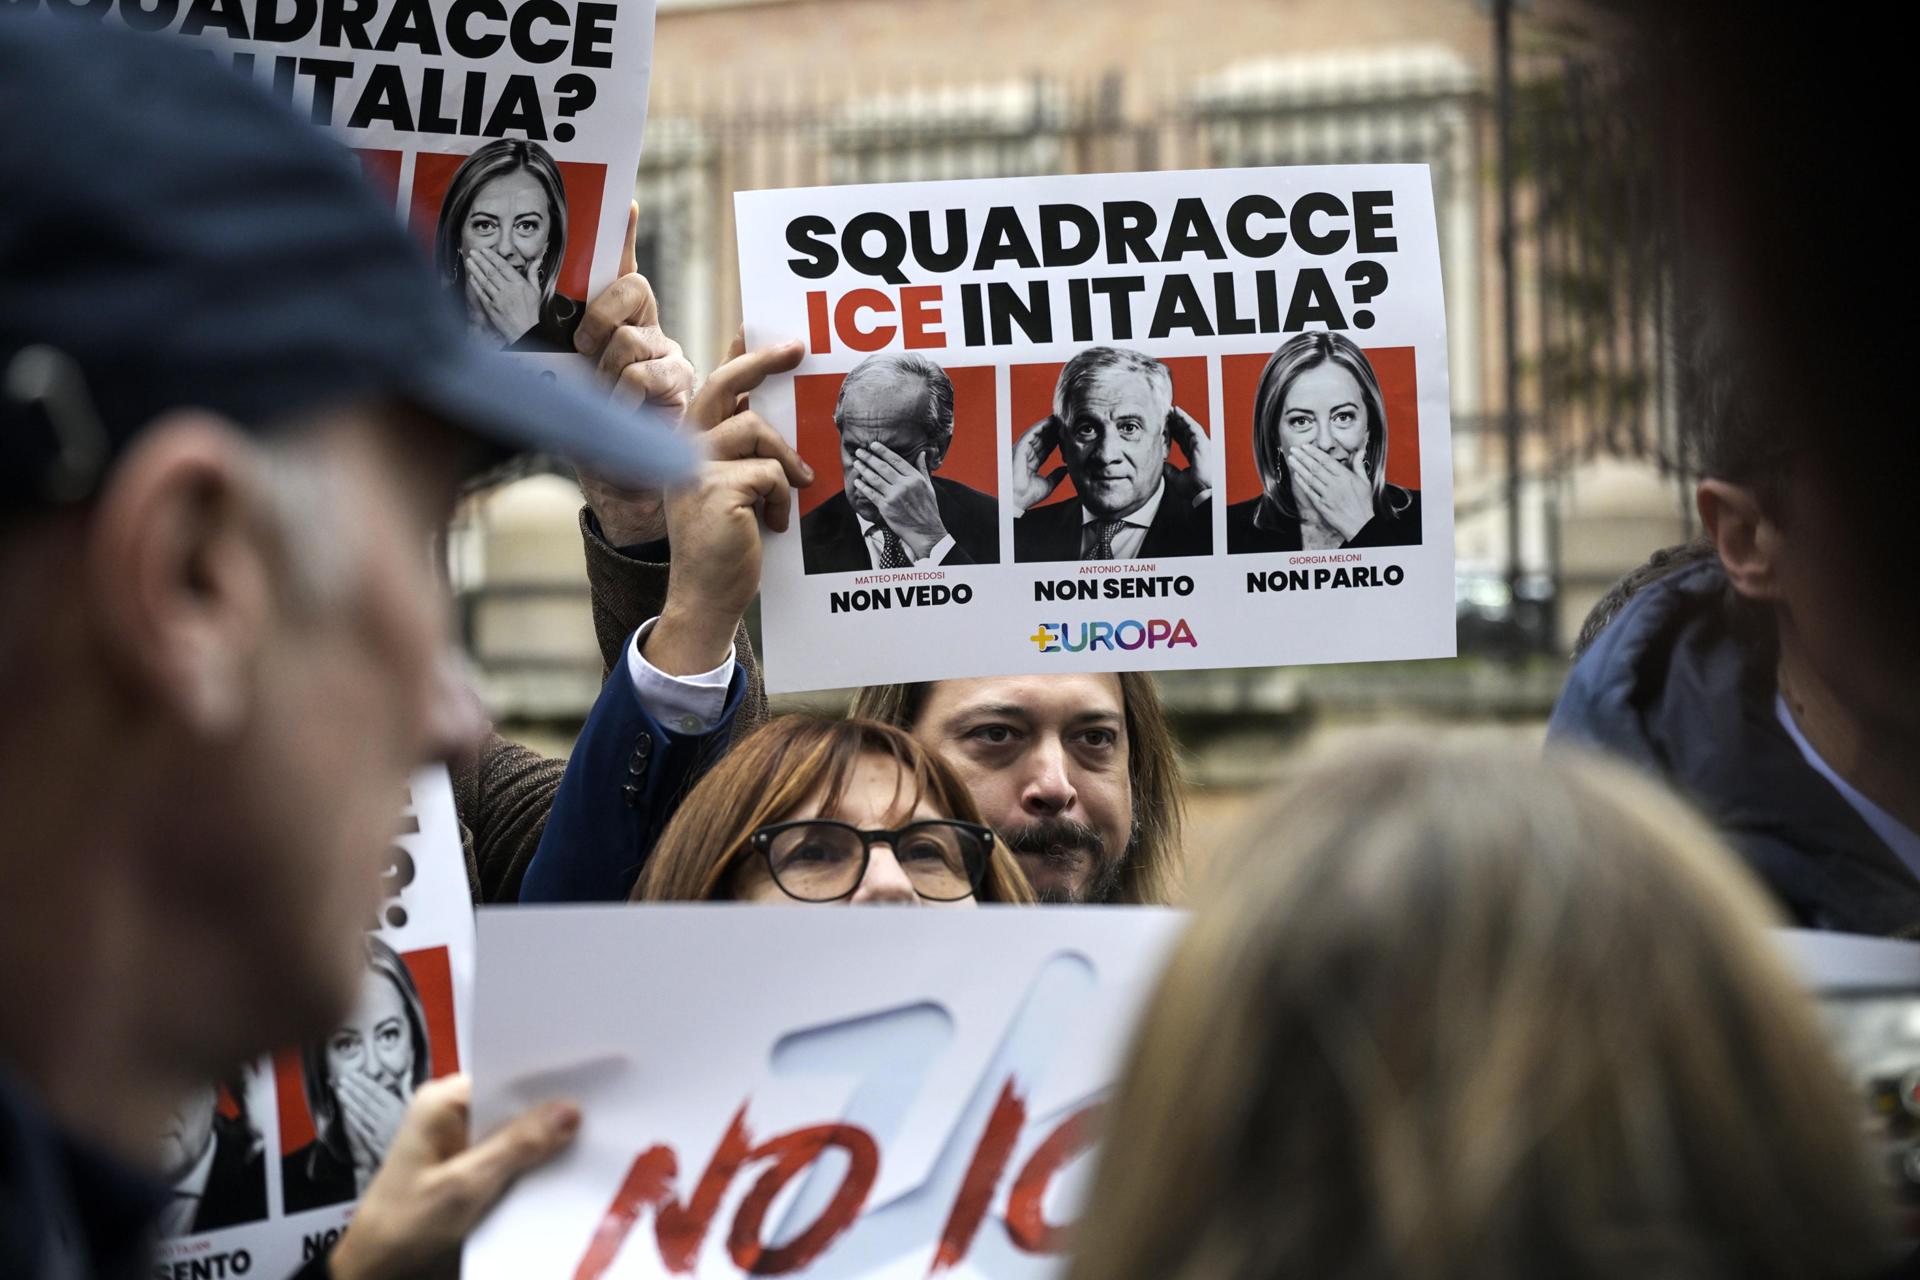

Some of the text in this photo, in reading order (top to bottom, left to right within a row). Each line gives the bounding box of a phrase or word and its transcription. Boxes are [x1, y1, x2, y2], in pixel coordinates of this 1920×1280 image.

[786, 190, 1398, 285] SQUADRACCE
[806, 260, 1389, 355] ICE IN ITALIA?
[1079, 563, 1156, 575] ANTONIO TAJANI
[1289, 553, 1362, 566] GIORGIA MELONI
[855, 571, 946, 585] MATTEO PIANTEDOSI
[1035, 575, 1195, 602] NON SENTO
[1247, 565, 1404, 593] NON PARLO
[830, 583, 973, 613] NON VEDO
[572, 1096, 878, 1280] NO
